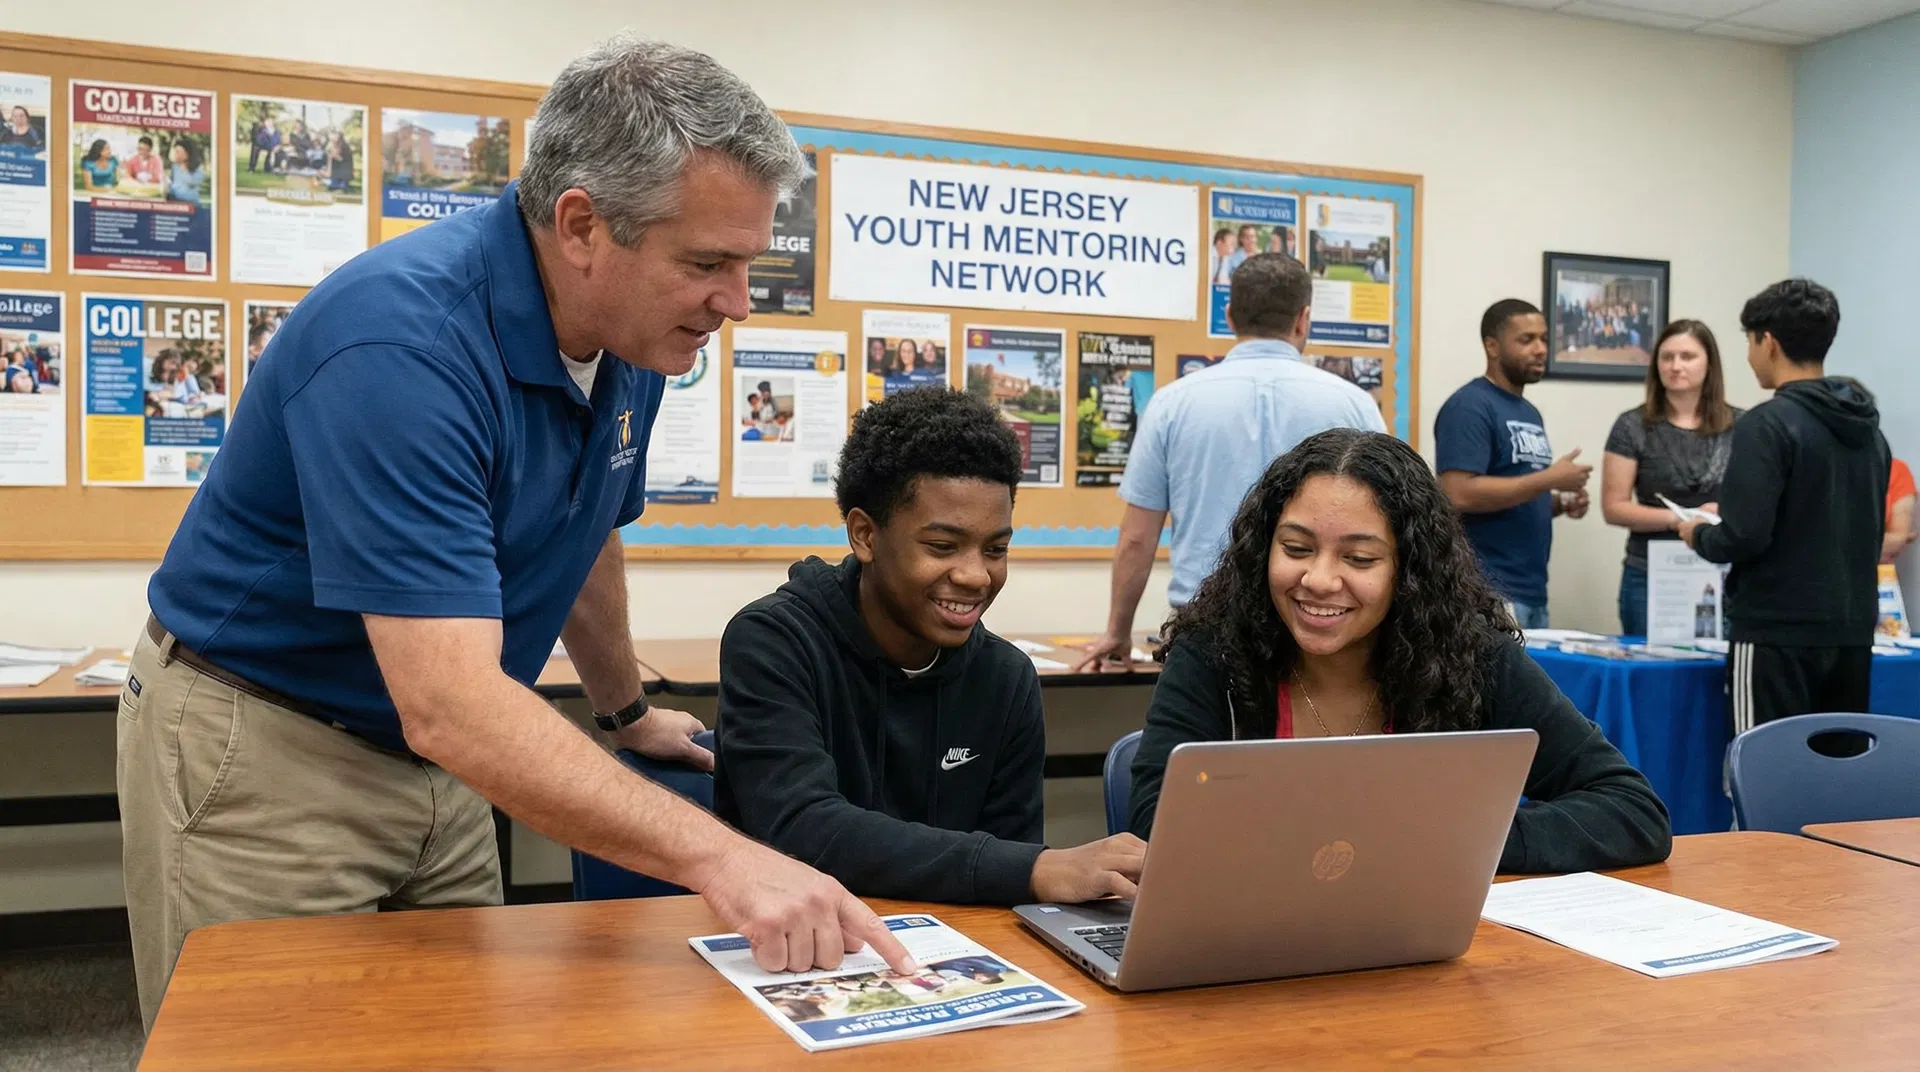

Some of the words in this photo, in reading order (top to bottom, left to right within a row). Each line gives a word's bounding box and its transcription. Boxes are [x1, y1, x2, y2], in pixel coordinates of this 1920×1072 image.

[84, 88, 201, 120] COLLEGE
[909, 179, 990, 212] NEW
[1000, 187, 1128, 223] JERSEY
[846, 213, 970, 250] YOUTH
[984, 224, 1186, 266] MENTORING
[931, 260, 1106, 298] NETWORK
[90, 304, 221, 340] COLLEGE
[946, 748, 971, 761] NIKE
